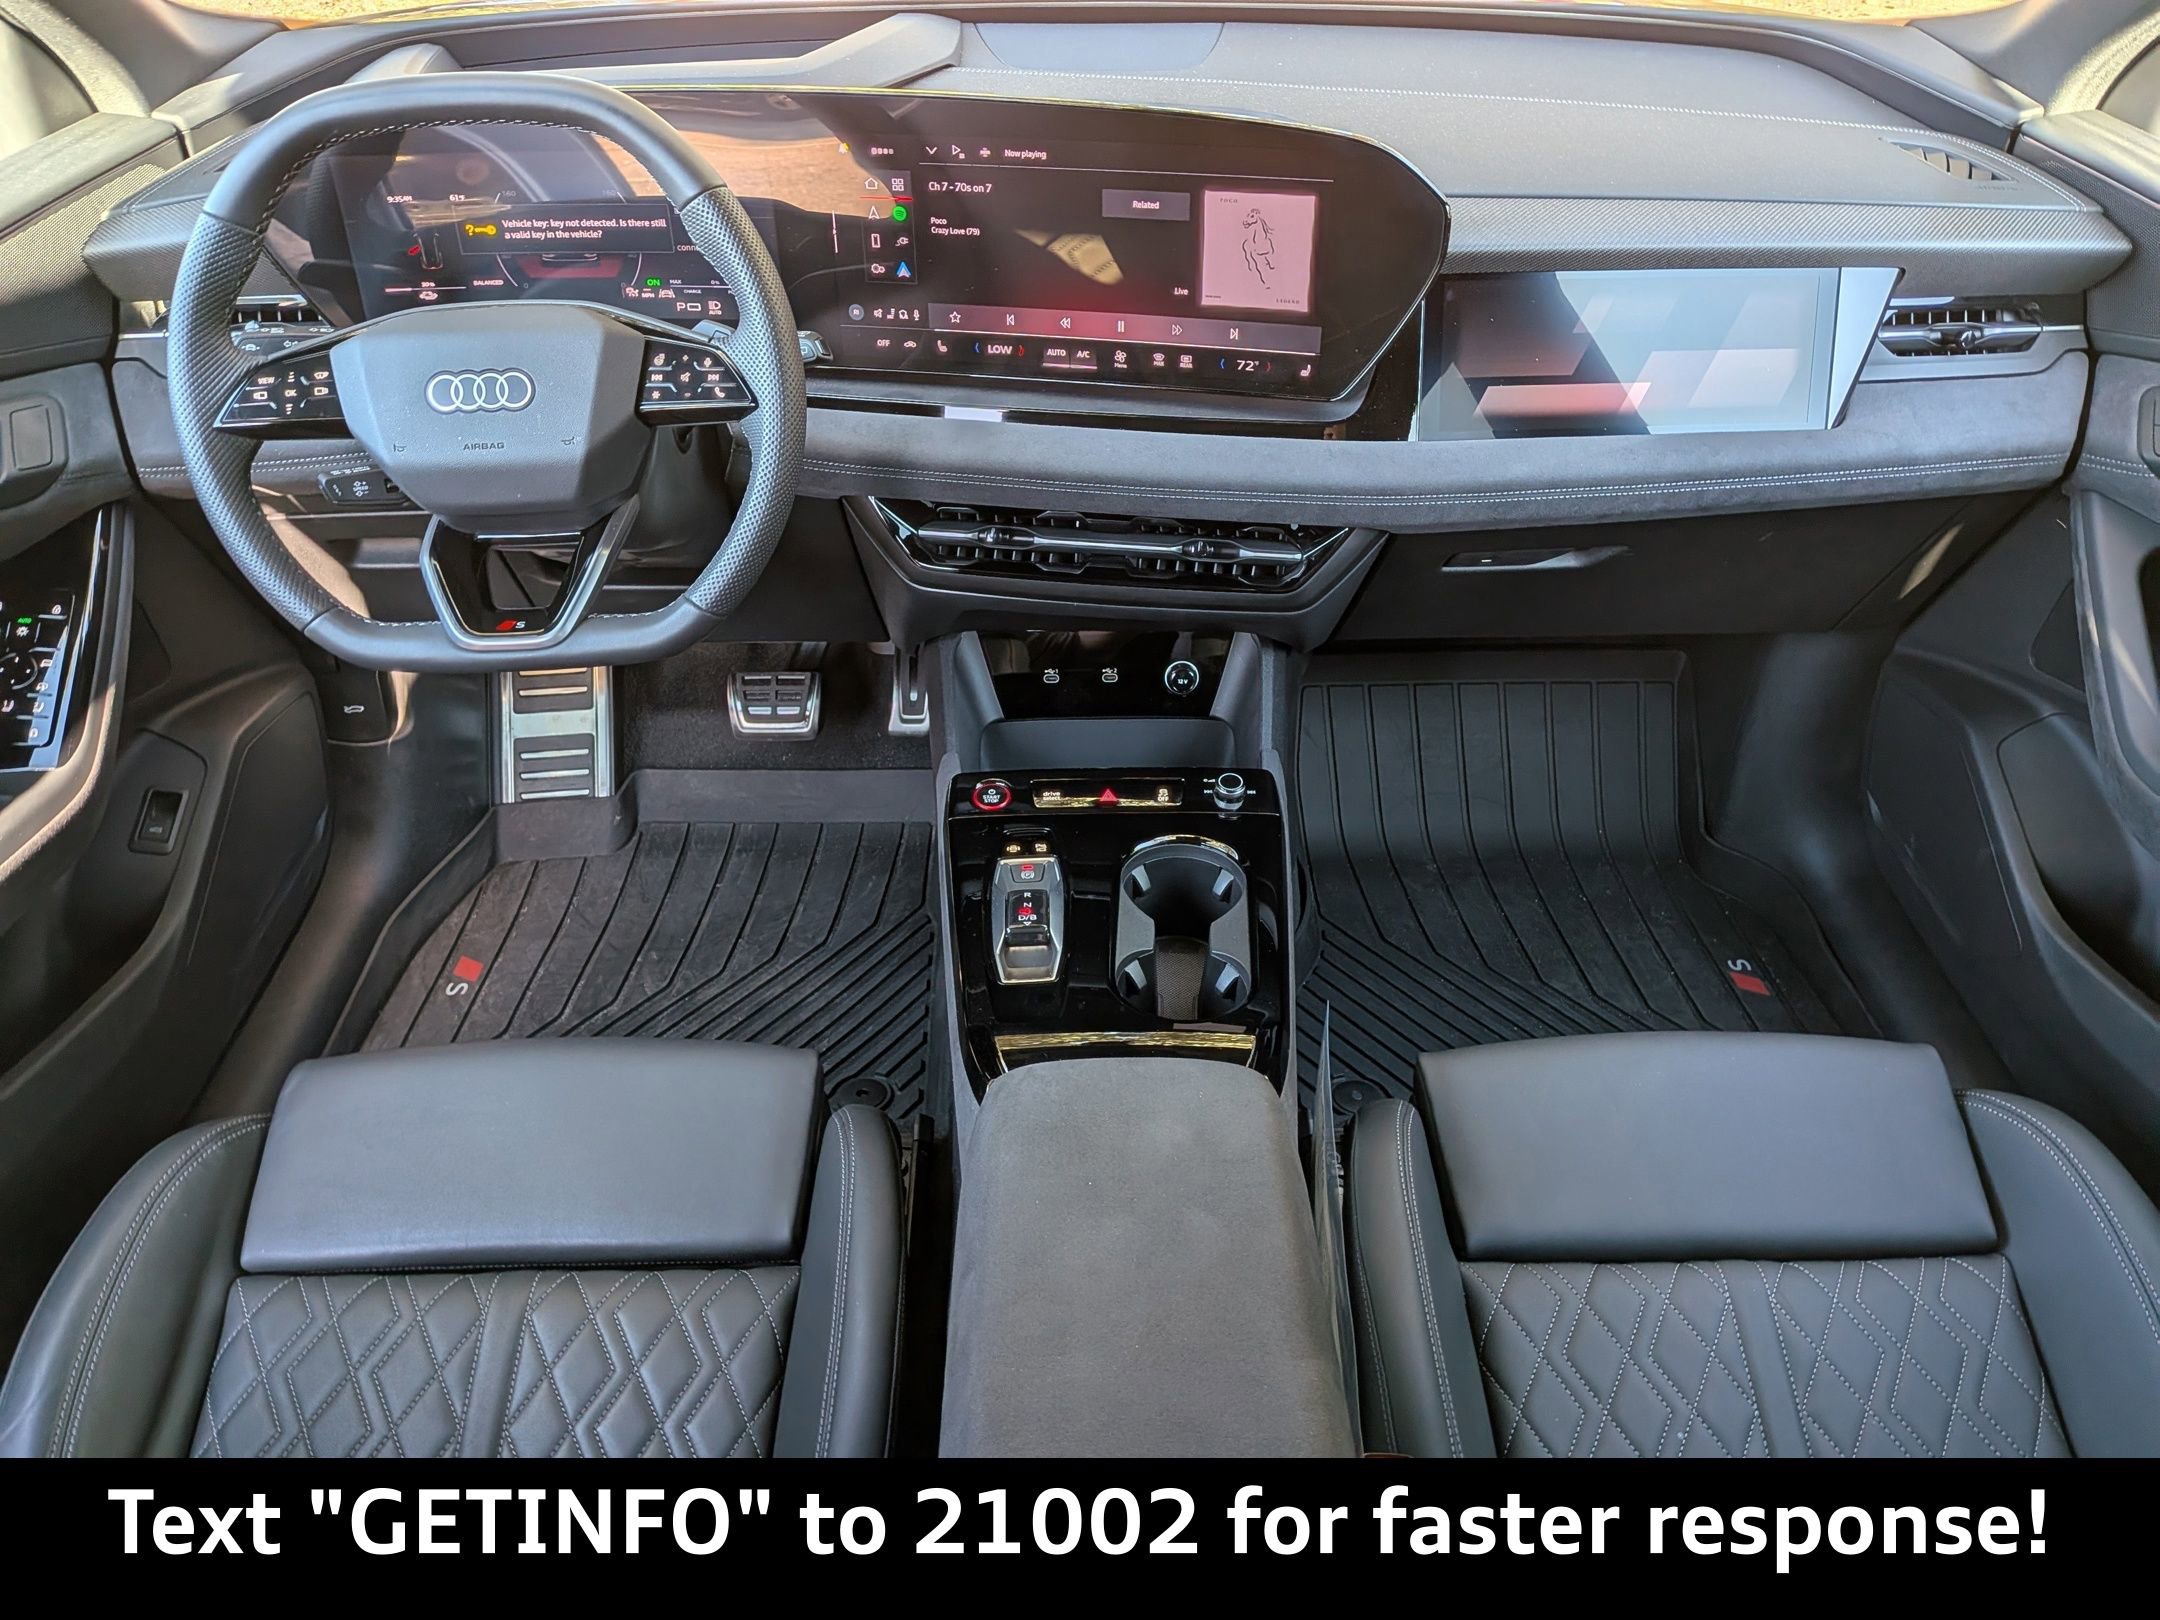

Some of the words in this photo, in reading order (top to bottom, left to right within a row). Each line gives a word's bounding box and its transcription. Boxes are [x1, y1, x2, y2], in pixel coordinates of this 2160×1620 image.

[1005, 149, 1021, 158] Now
[1022, 150, 1047, 160] playing
[928, 182, 941, 191] Ch
[941, 182, 948, 191] 7
[955, 183, 972, 192] 70s
[986, 183, 992, 193] 7
[1132, 200, 1160, 209] Related
[502, 219, 531, 228] Vehicle
[550, 219, 564, 229] key
[581, 219, 618, 227] detected.
[620, 219, 627, 227] Is
[628, 219, 649, 227] there
[651, 219, 667, 227] still
[931, 217, 947, 225] Poco
[511, 231, 530, 239] valid
[532, 231, 545, 240] key
[571, 230, 602, 238] vehicle?
[931, 227, 949, 236] Crazy
[950, 227, 965, 235] Love
[966, 227, 980, 236] (79)
[1174, 287, 1189, 295] Live
[676, 302, 685, 311] P
[877, 339, 890, 347] OFF
[988, 344, 1012, 354] LOW
[1047, 349, 1066, 357] AUTO
[1077, 350, 1090, 358] A/C
[285, 389, 297, 397] OK
[463, 442, 504, 450] AIRBAG
[515, 621, 526, 629] S
[1727, 958, 1752, 971] S
[446, 982, 469, 996] S
